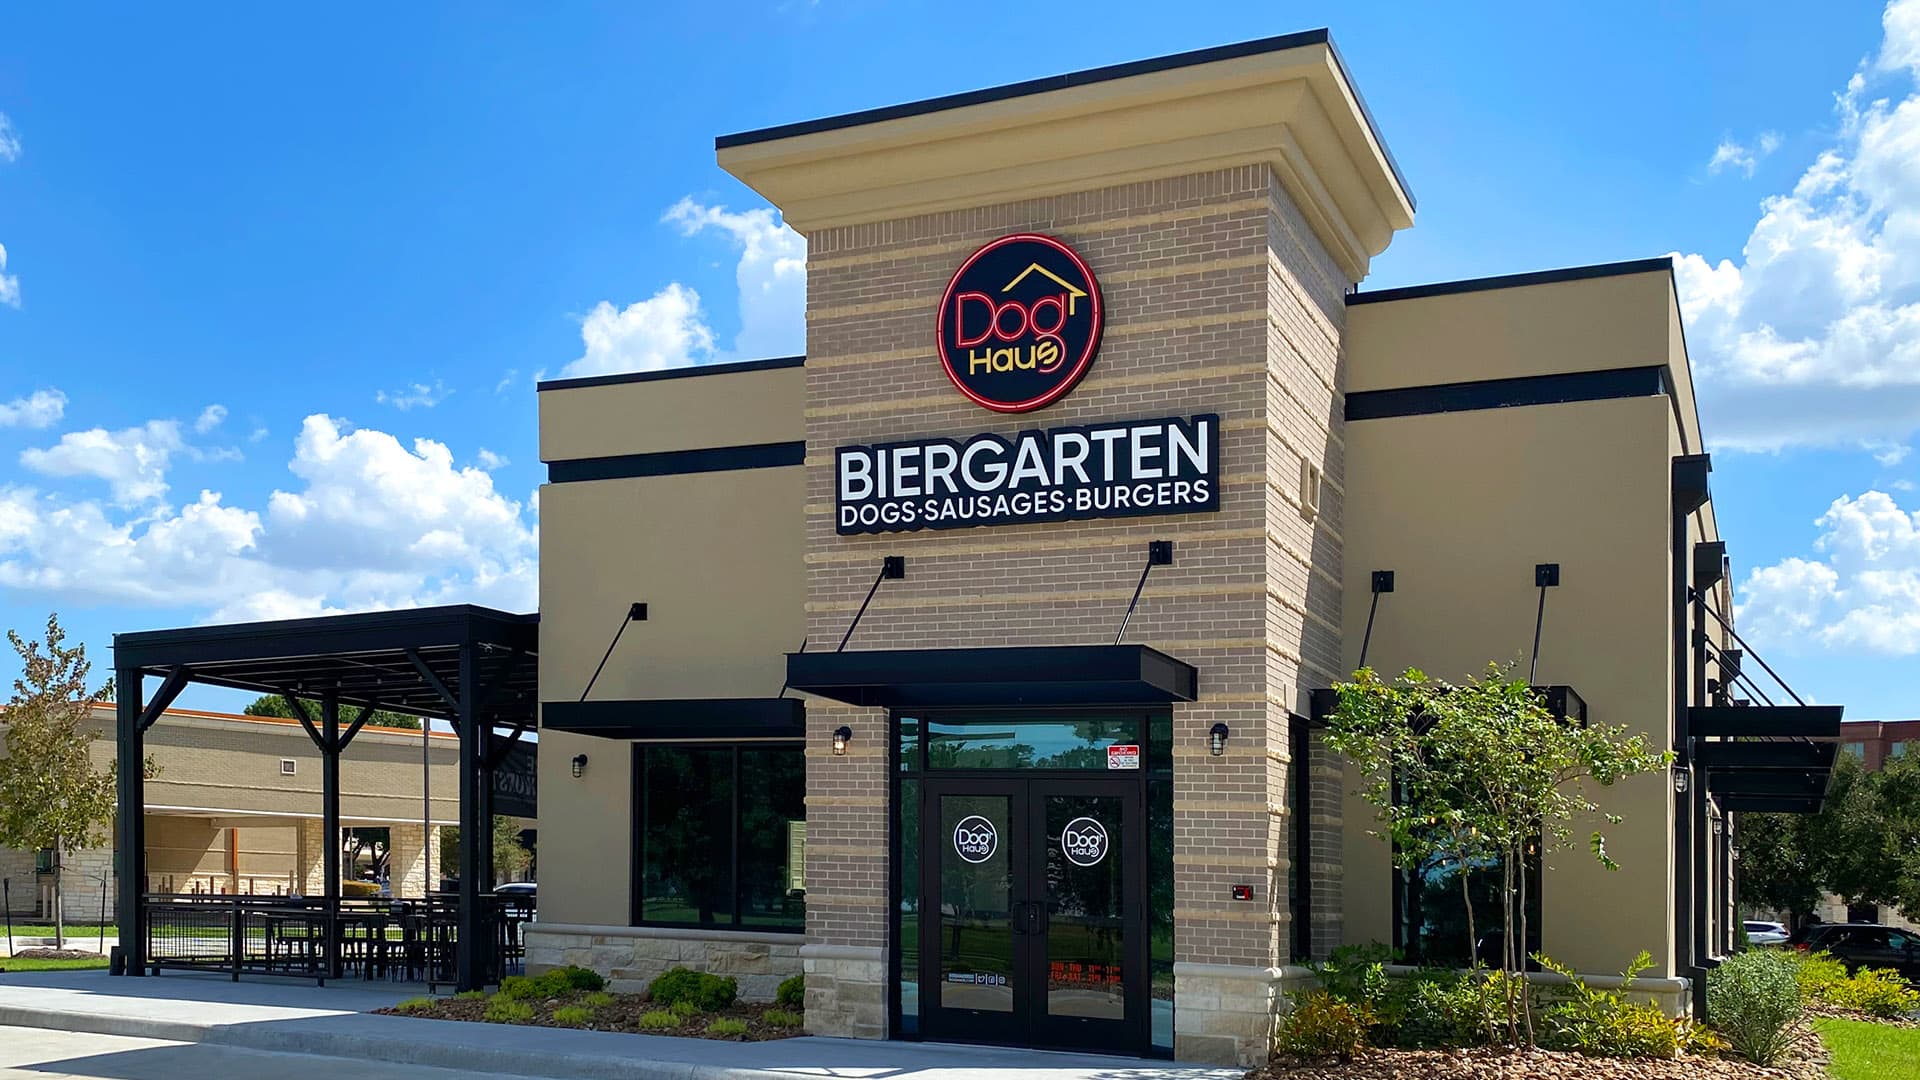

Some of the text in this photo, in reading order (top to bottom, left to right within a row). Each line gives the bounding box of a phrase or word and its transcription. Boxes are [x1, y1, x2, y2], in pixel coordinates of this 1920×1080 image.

[955, 290, 1067, 374] Dog
[969, 340, 1059, 376] Haus
[840, 421, 1209, 501] BIERGARTEN
[958, 828, 990, 855] Dog
[1067, 830, 1100, 857] Dog
